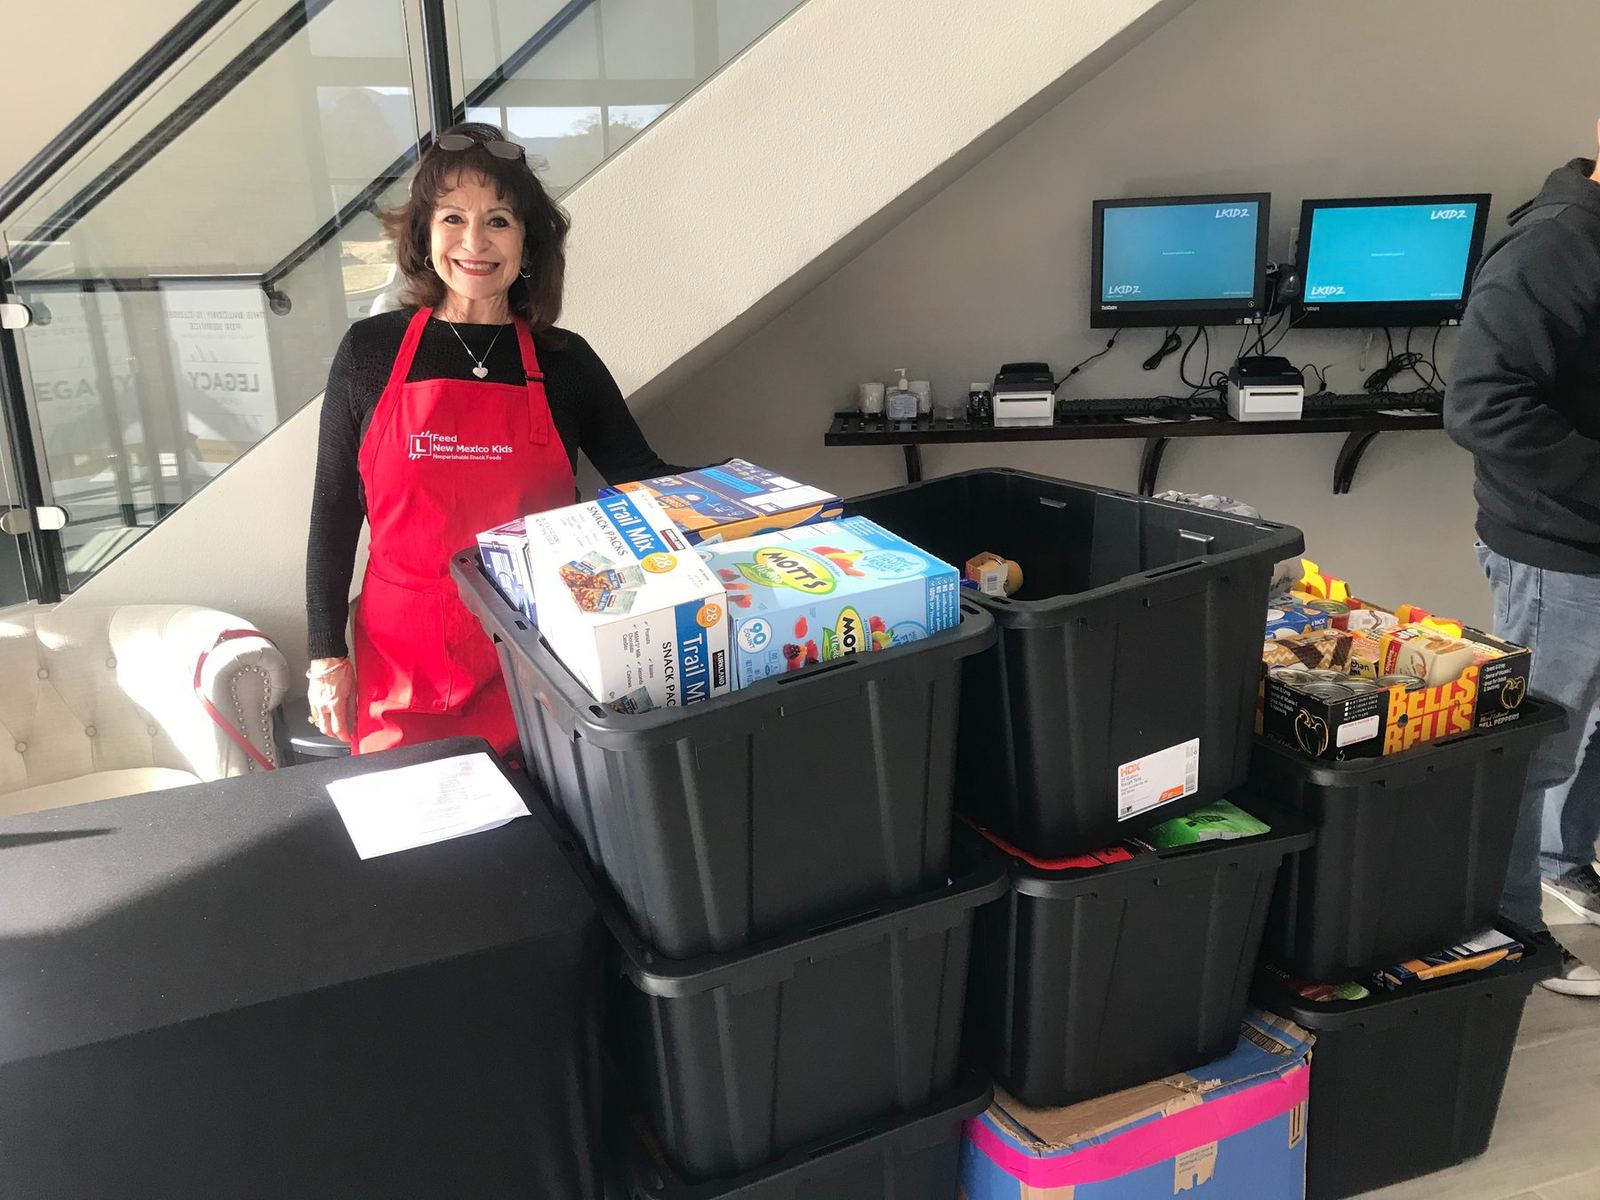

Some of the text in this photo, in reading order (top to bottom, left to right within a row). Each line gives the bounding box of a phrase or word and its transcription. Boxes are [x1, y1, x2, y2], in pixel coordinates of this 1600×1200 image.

[433, 433, 458, 442] Feed
[433, 444, 513, 453] New Mexico Kids
[587, 506, 629, 557] SNACK PACKS
[606, 499, 642, 528] Trail
[625, 526, 656, 552] Mix
[652, 555, 673, 569] 28
[706, 607, 718, 622] 28
[744, 629, 756, 649] COUNT
[750, 622, 766, 645] 90
[662, 641, 676, 708] SNACK PAC
[683, 633, 706, 706] Trail Mi
[1386, 665, 1479, 725] BELLS
[1120, 762, 1140, 778] HDX
